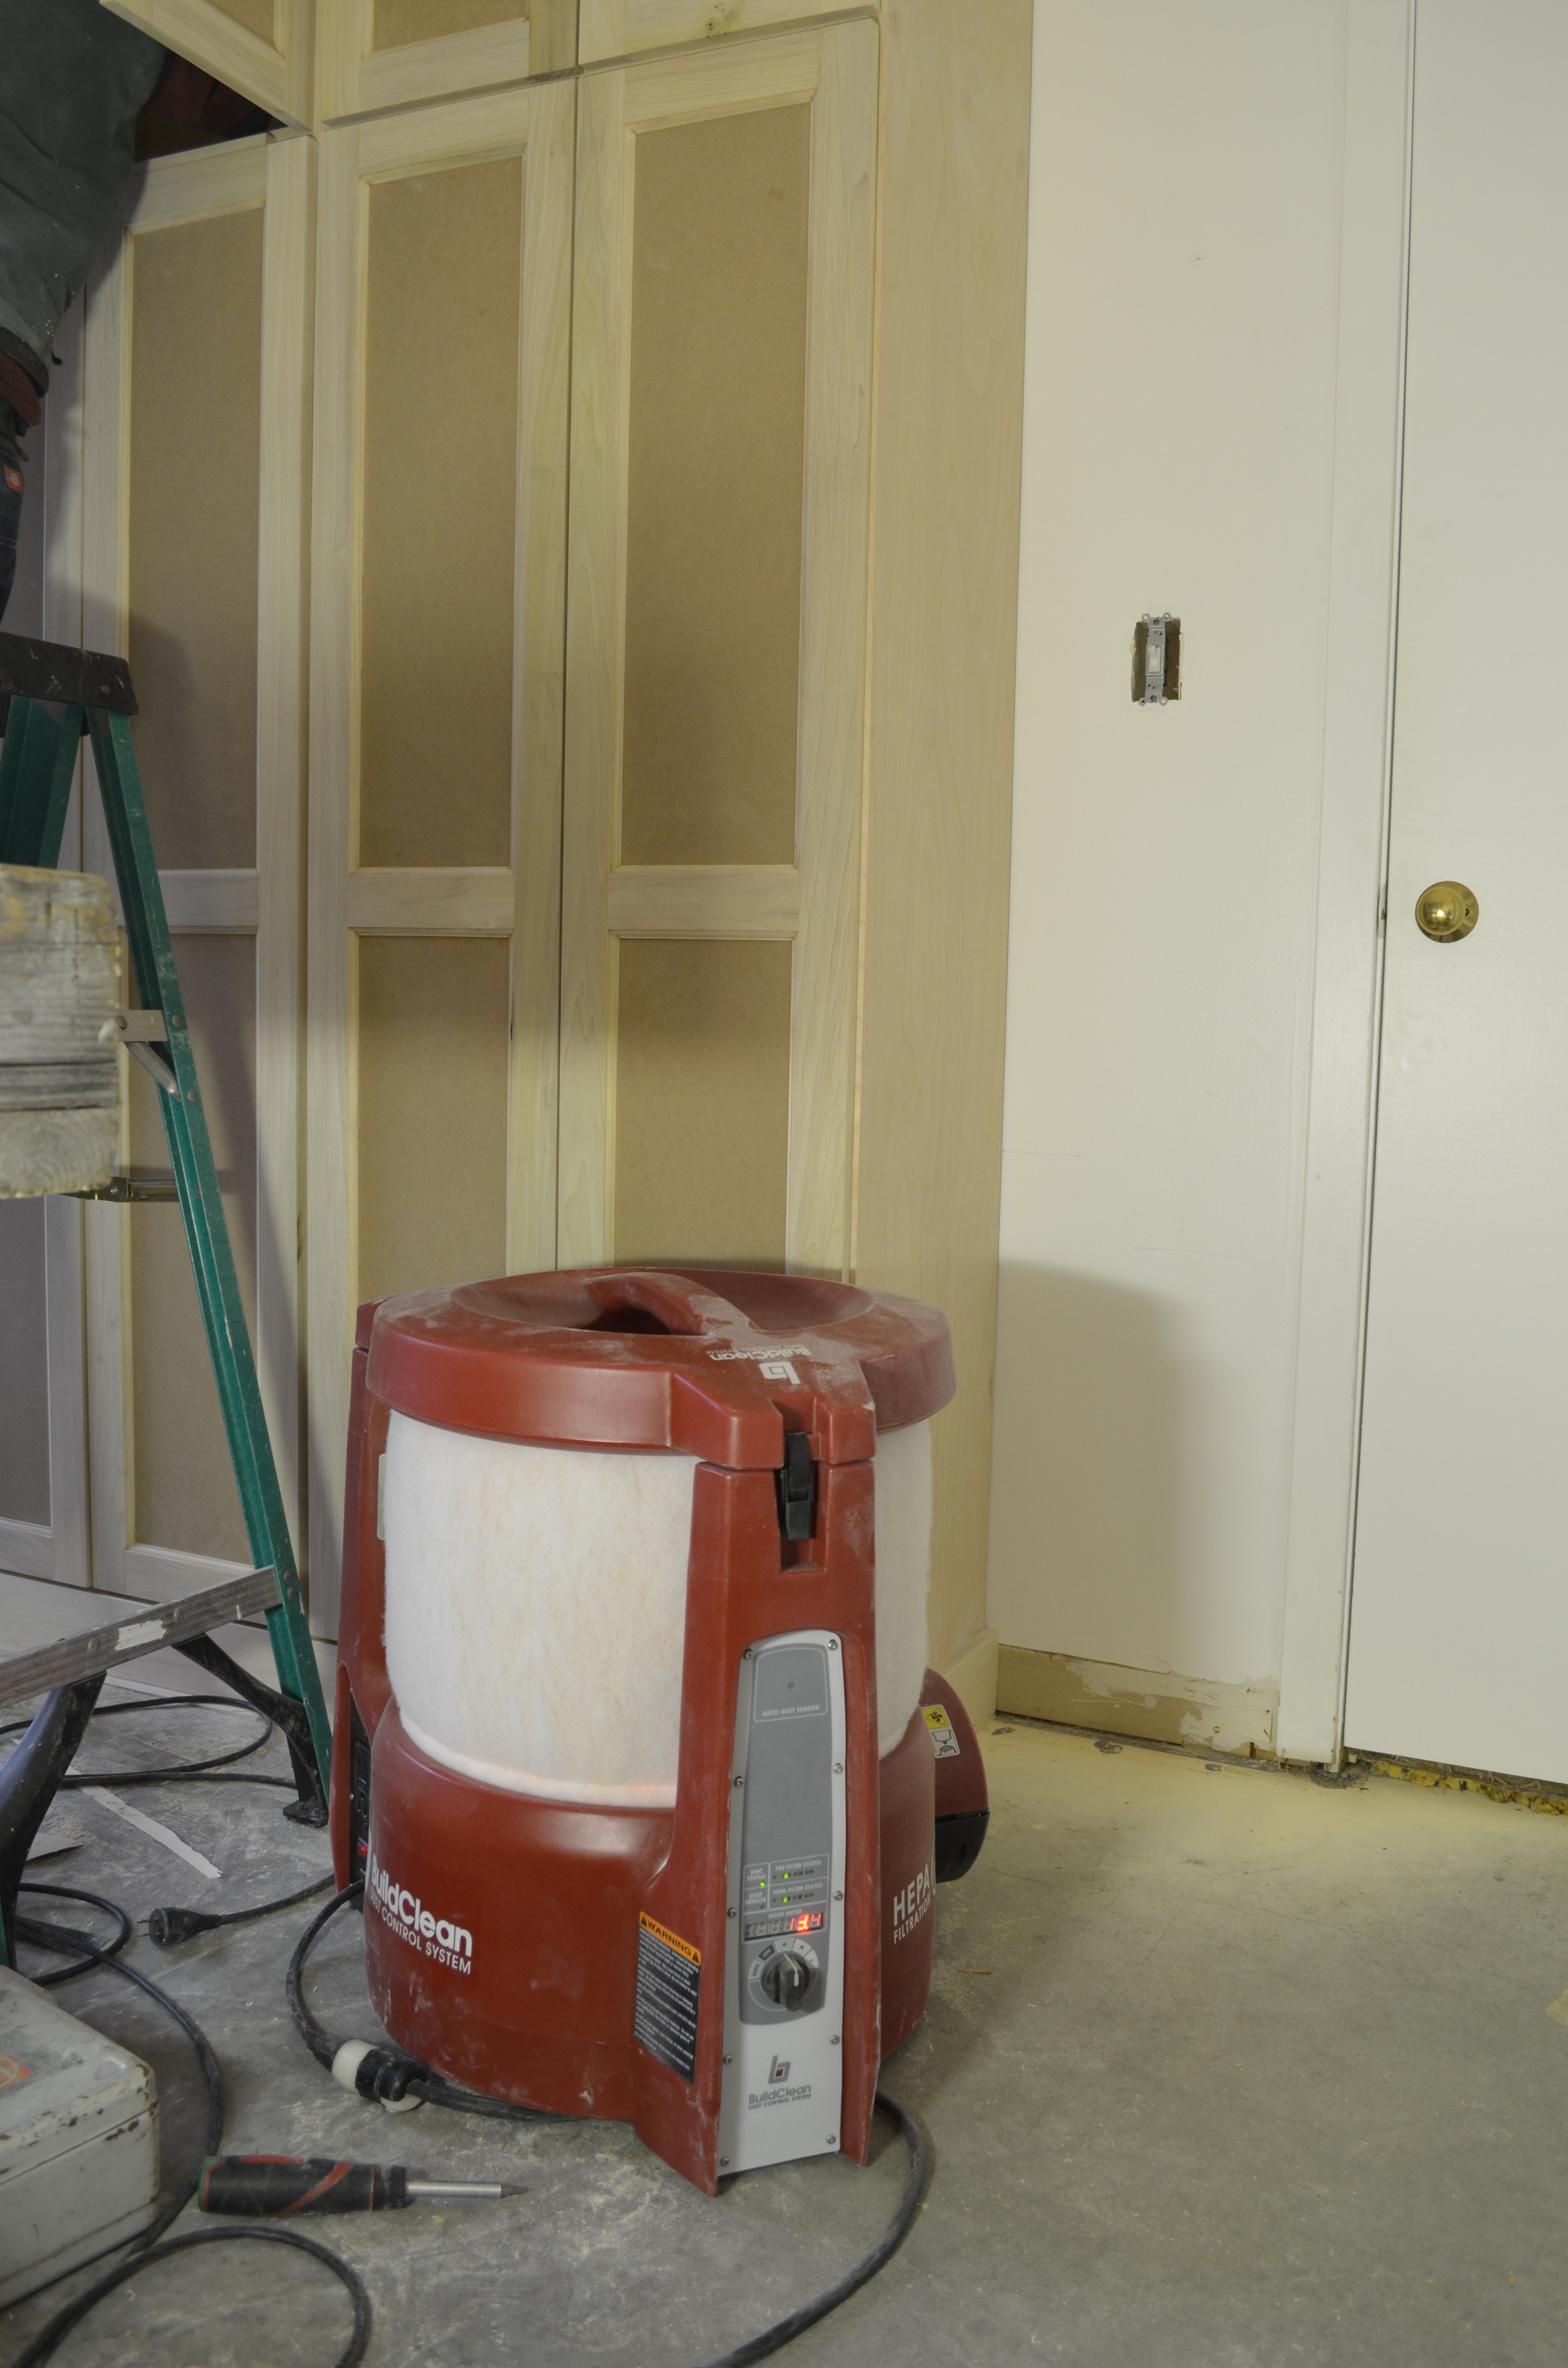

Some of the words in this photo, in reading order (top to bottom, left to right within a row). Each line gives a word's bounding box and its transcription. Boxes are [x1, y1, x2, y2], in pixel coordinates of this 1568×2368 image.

[710, 1348, 811, 1360] BuildClean
[372, 1853, 472, 1957] BuildClean
[894, 1863, 930, 1926] HEPA
[894, 1892, 931, 1945] FILTRATION
[381, 1907, 421, 1950] CONTROL
[426, 1942, 471, 1974] SYSTEM
[647, 1920, 691, 1956] WARNING
[762, 1949, 771, 1957] OFF
[749, 2085, 811, 2104] BuildClean
[763, 2098, 789, 2107] CONTROL
